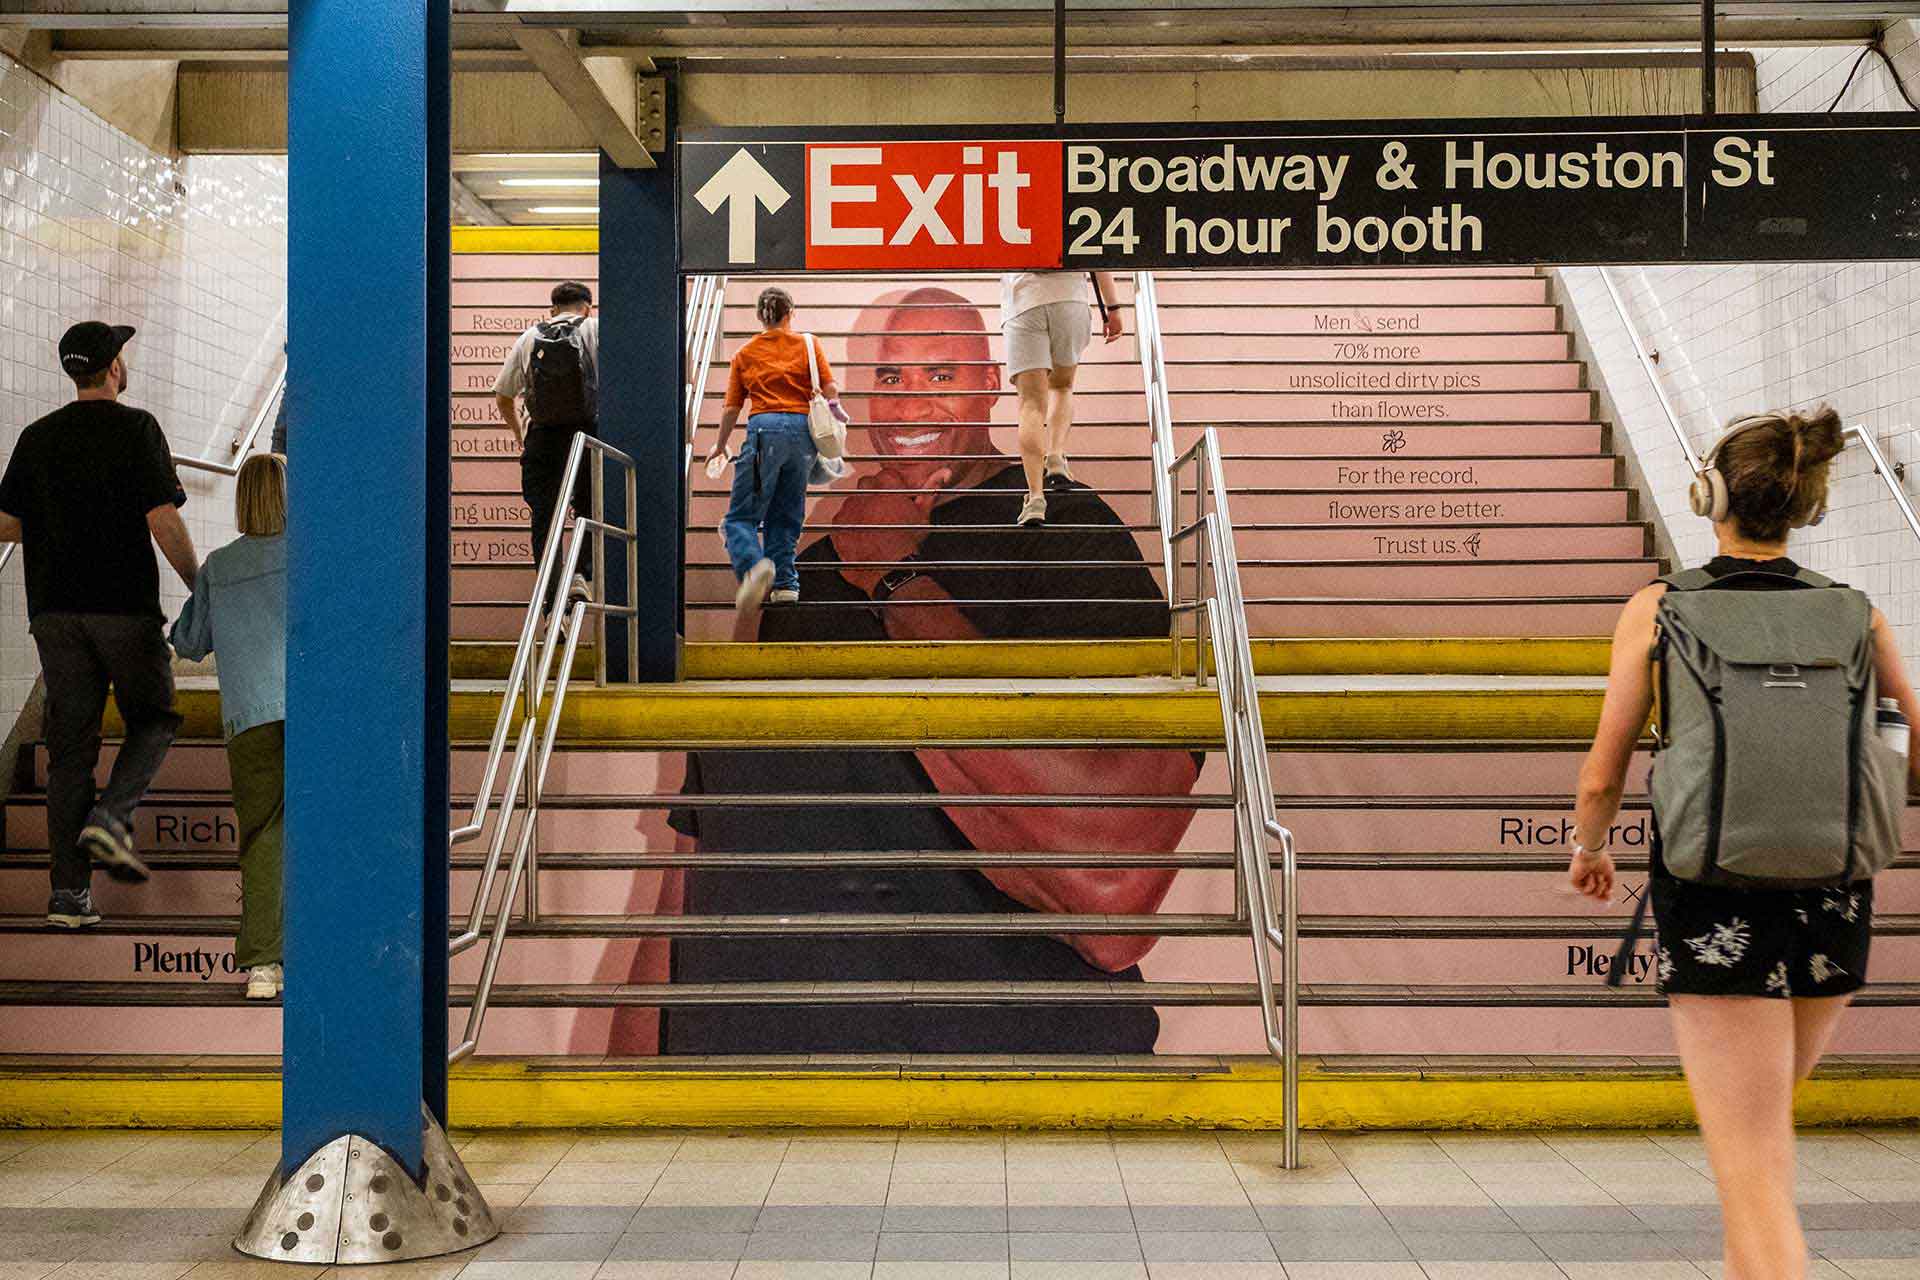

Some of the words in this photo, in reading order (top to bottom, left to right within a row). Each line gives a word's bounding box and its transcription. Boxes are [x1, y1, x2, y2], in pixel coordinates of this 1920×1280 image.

[1068, 144, 1350, 200] Broadway
[1376, 141, 1418, 190] &
[1445, 140, 1684, 189] Houston
[1711, 136, 1774, 187] St
[810, 146, 1032, 246] Exit
[1068, 207, 1140, 255] 24
[1166, 206, 1291, 254] hour
[1316, 204, 1483, 253] booth
[1313, 314, 1351, 330] Men
[1376, 313, 1420, 330] send
[1333, 343, 1369, 359] 70%
[1373, 346, 1421, 359] more
[1289, 372, 1390, 388] unsolicited
[1395, 372, 1439, 391] dirty
[1443, 372, 1481, 391] pics
[1331, 401, 1373, 418] than
[1377, 401, 1450, 418] flowers.
[1337, 466, 1369, 484] For
[1374, 466, 1404, 484] the
[1409, 466, 1479, 486] record,
[1328, 501, 1400, 519] flowers
[1404, 504, 1436, 518] are
[1441, 501, 1505, 518] better.
[1374, 536, 1427, 554] Trust
[1432, 539, 1461, 554] us.
[155, 815, 236, 843] Rich
[1501, 817, 1646, 846] Richrd
